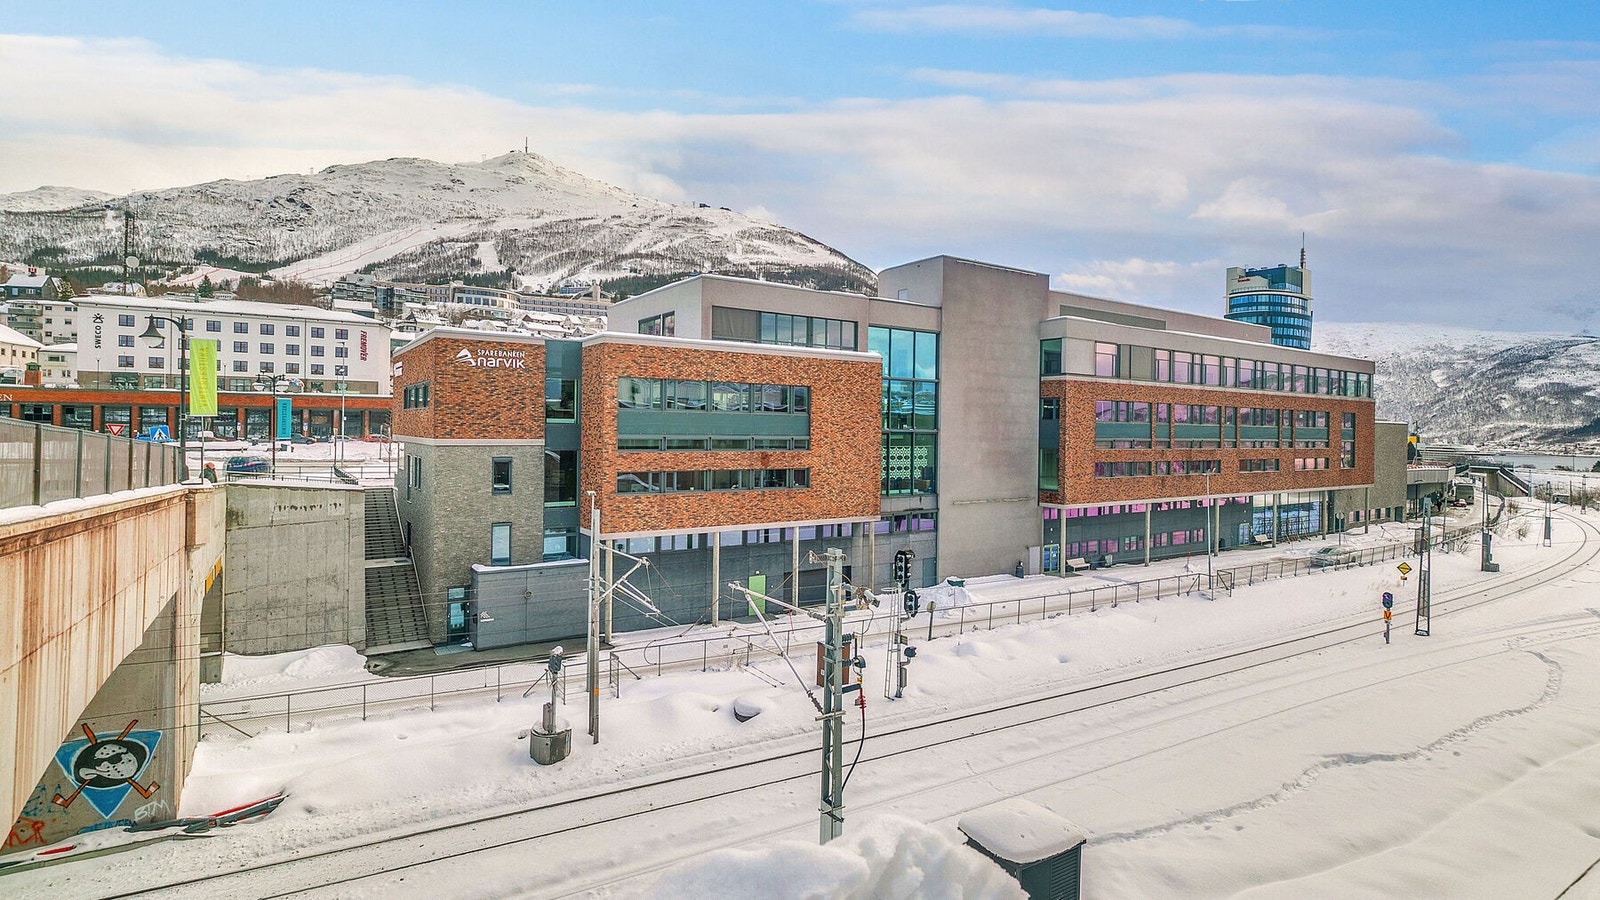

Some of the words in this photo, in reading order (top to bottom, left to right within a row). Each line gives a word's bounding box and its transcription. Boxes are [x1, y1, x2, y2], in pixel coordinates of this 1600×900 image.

[94, 325, 102, 349] SWECO
[477, 349, 525, 358] SPAREBANKEN
[477, 356, 526, 369] narvik
